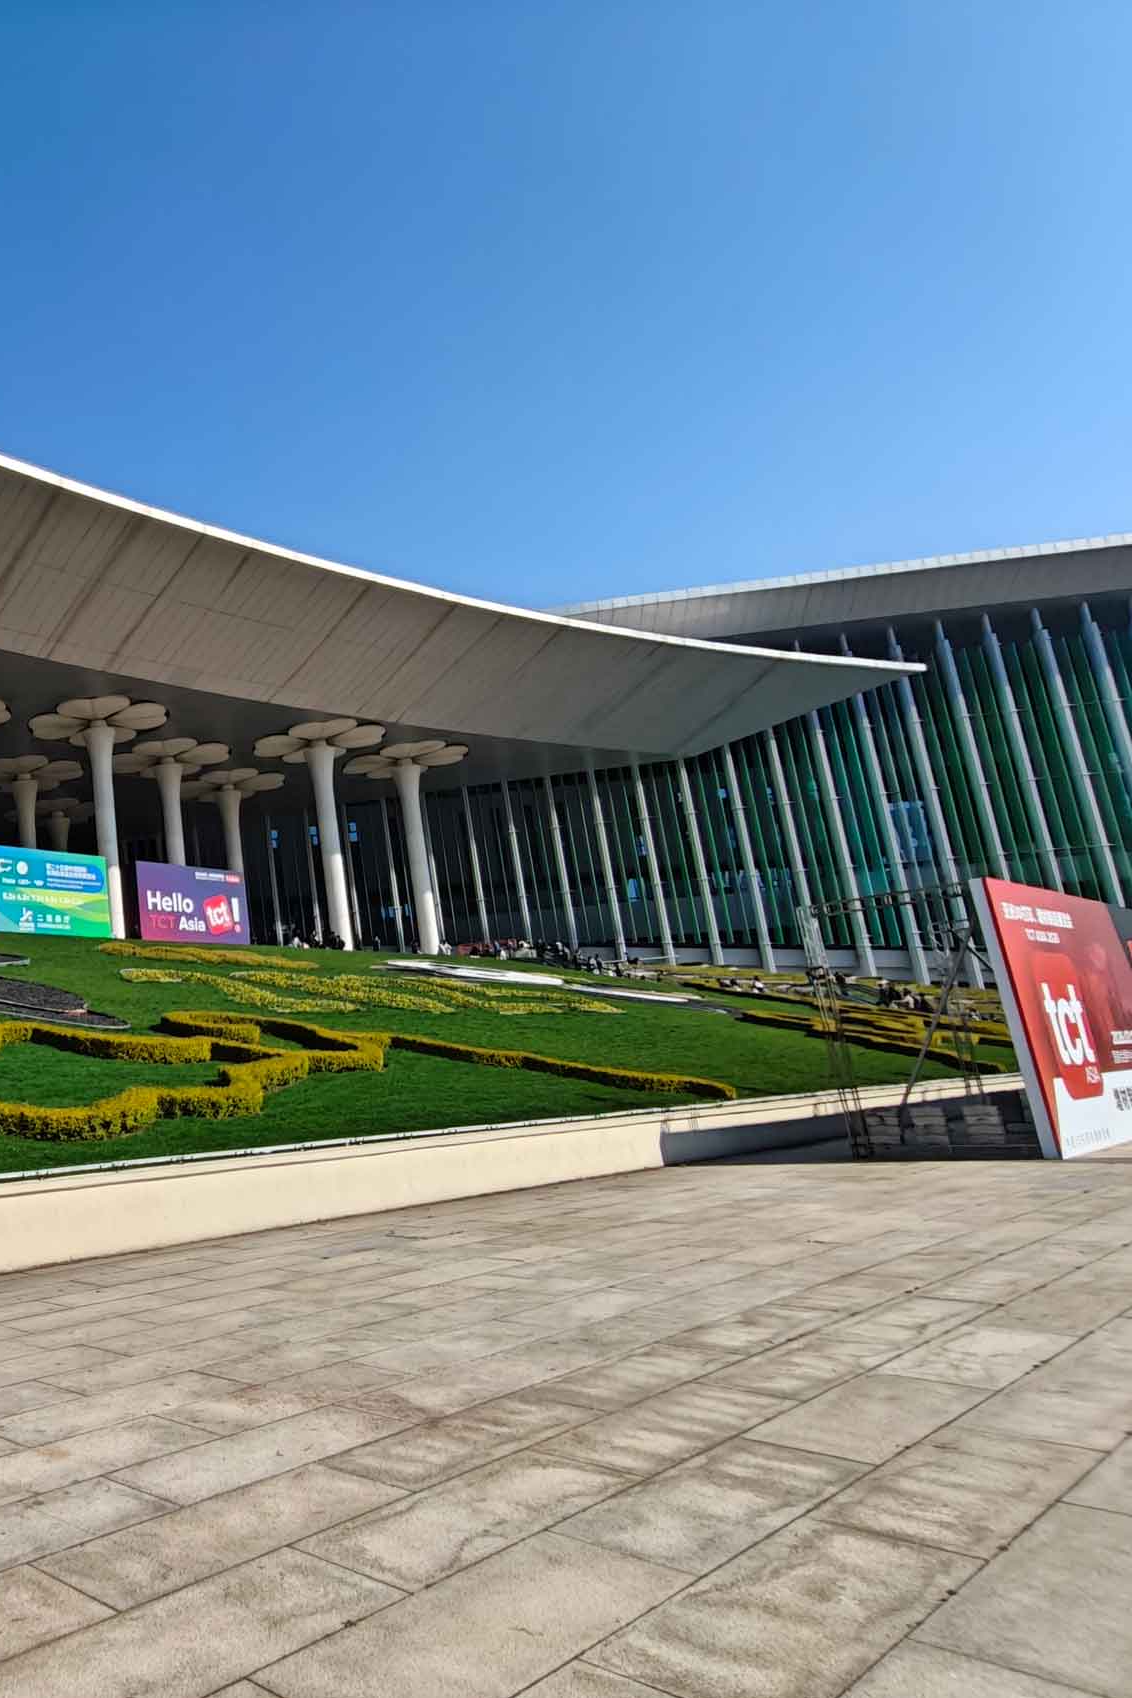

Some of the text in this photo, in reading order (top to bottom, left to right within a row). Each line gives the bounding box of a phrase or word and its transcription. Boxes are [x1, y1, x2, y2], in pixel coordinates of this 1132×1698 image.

[147, 890, 193, 913] Hello
[148, 915, 206, 932] TCT Asia
[206, 903, 230, 926] tct
[1040, 981, 1096, 1066] tct
